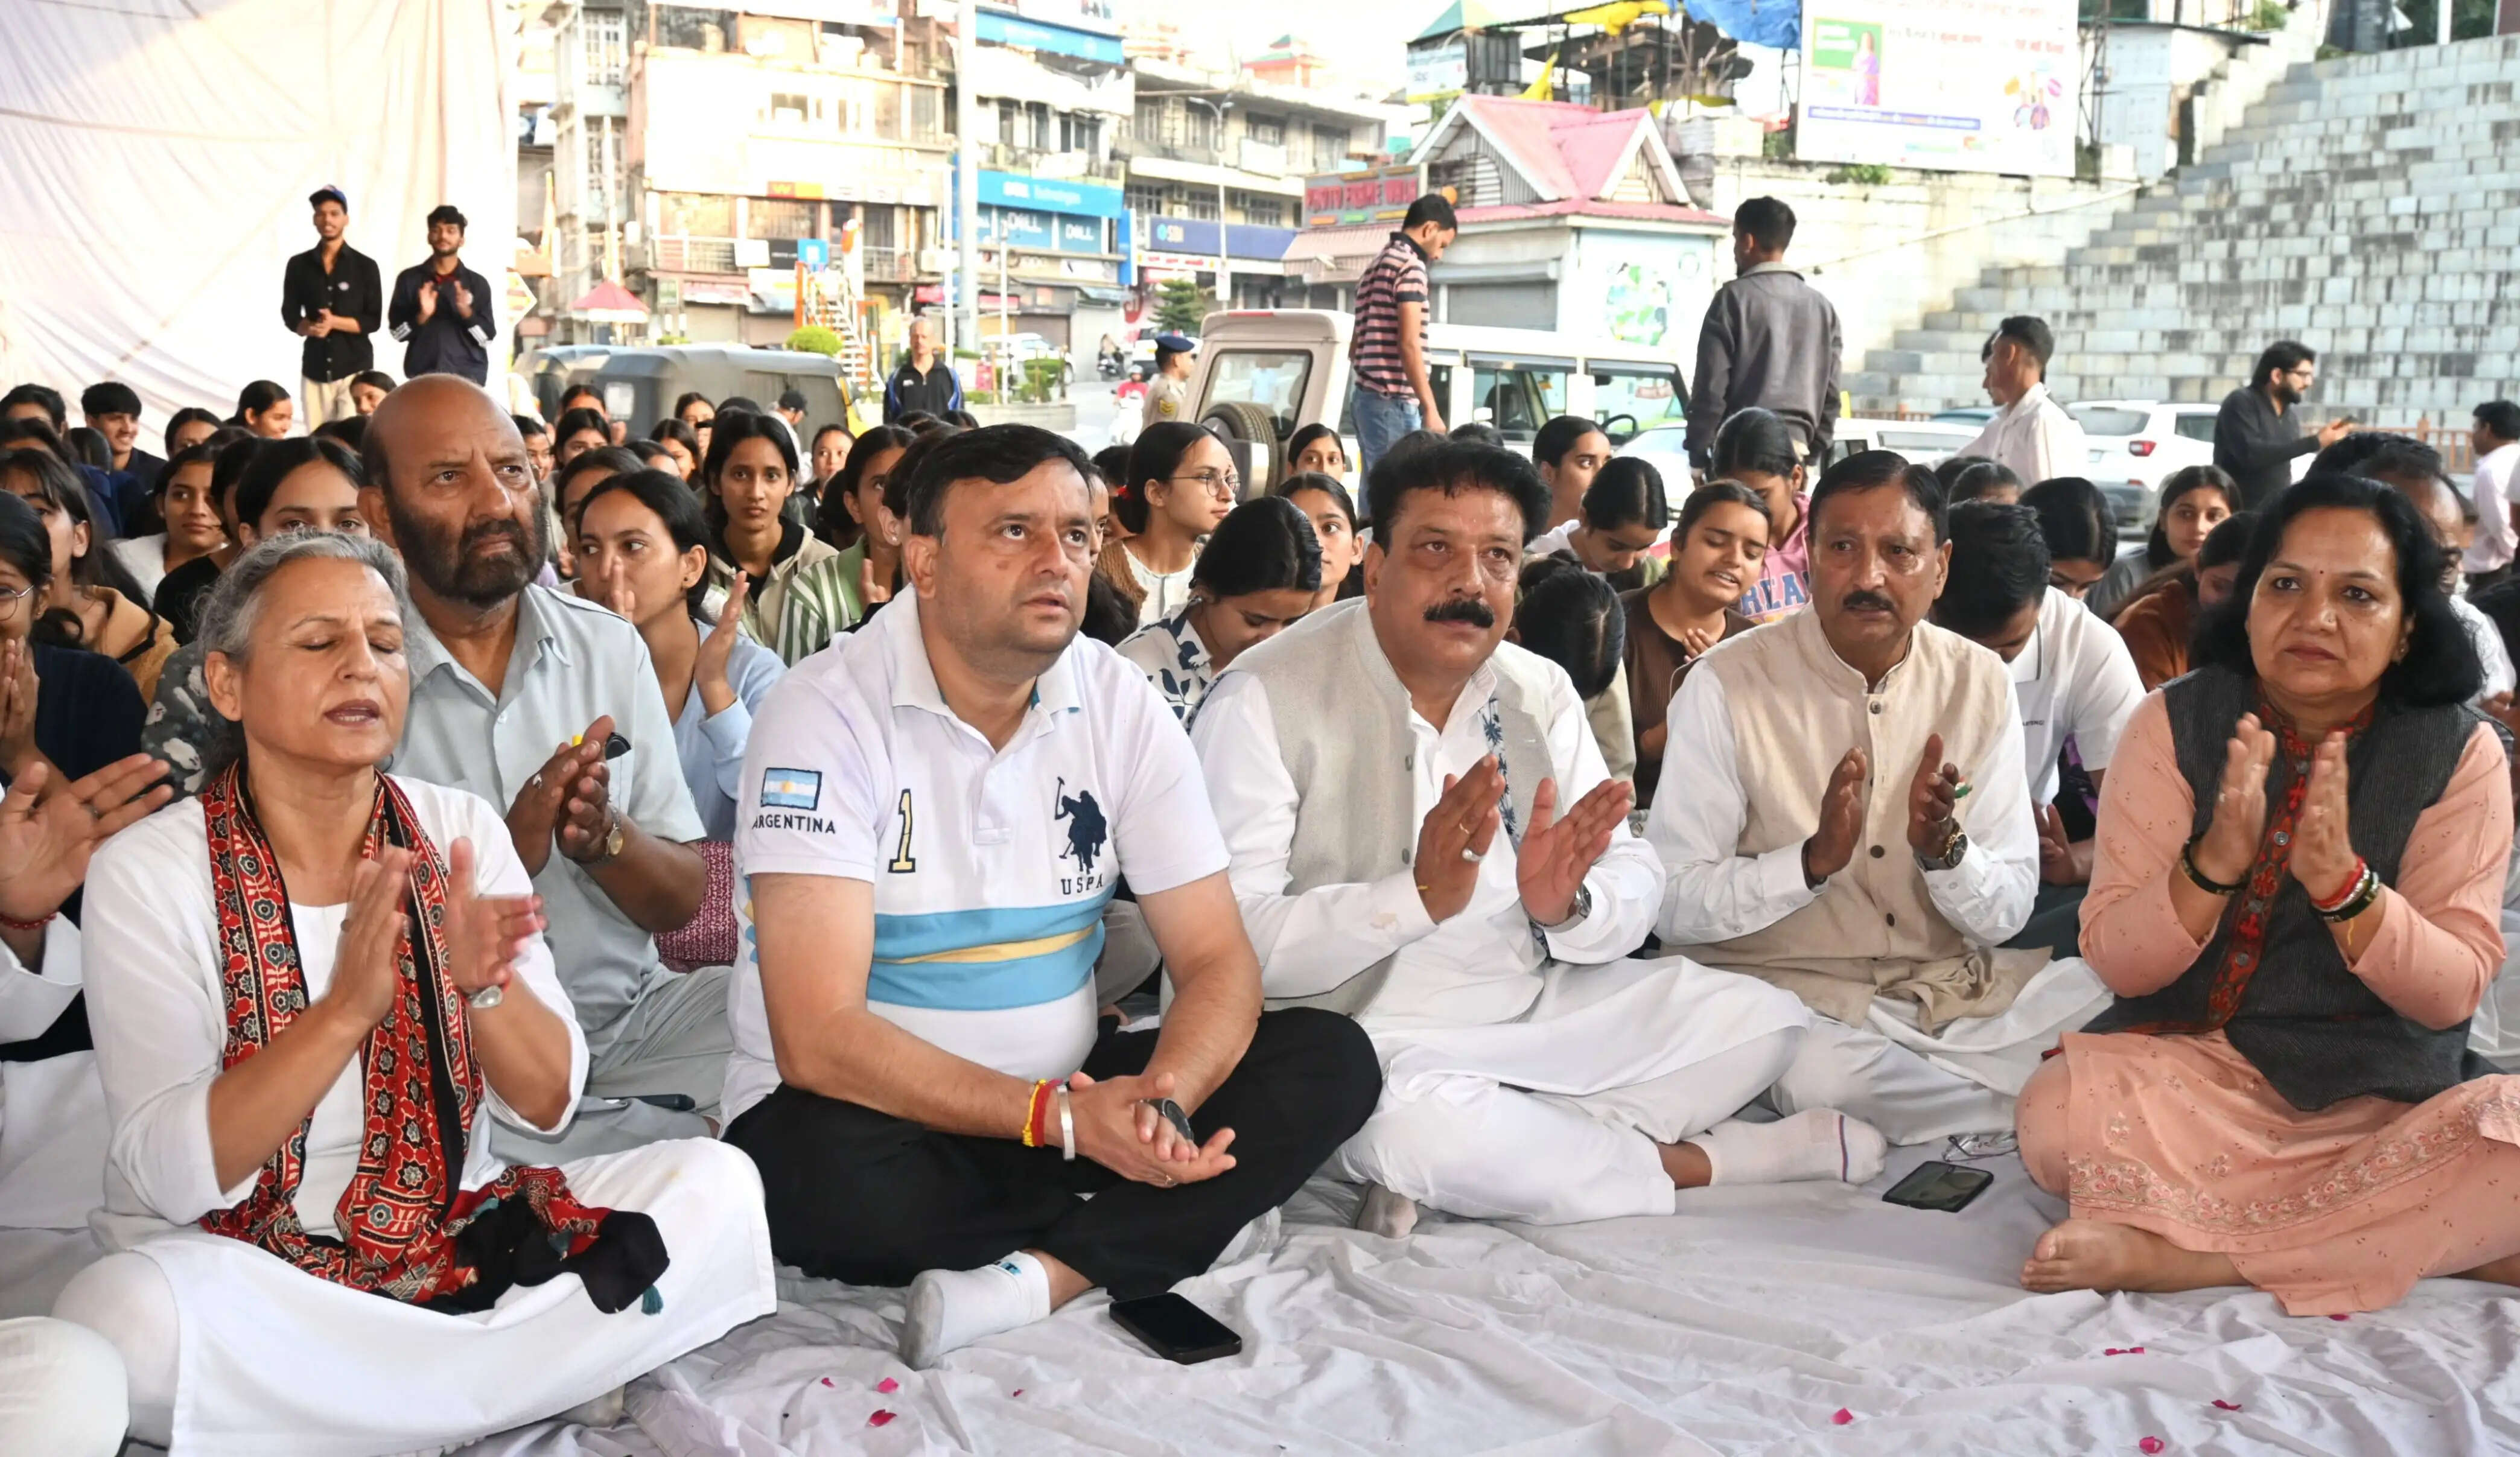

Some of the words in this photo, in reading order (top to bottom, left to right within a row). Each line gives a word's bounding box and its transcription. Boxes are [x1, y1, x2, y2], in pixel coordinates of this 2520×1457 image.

[752, 814, 836, 834] ARGENTINA
[888, 789, 916, 873] 1
[1060, 874, 1104, 895] USPA
